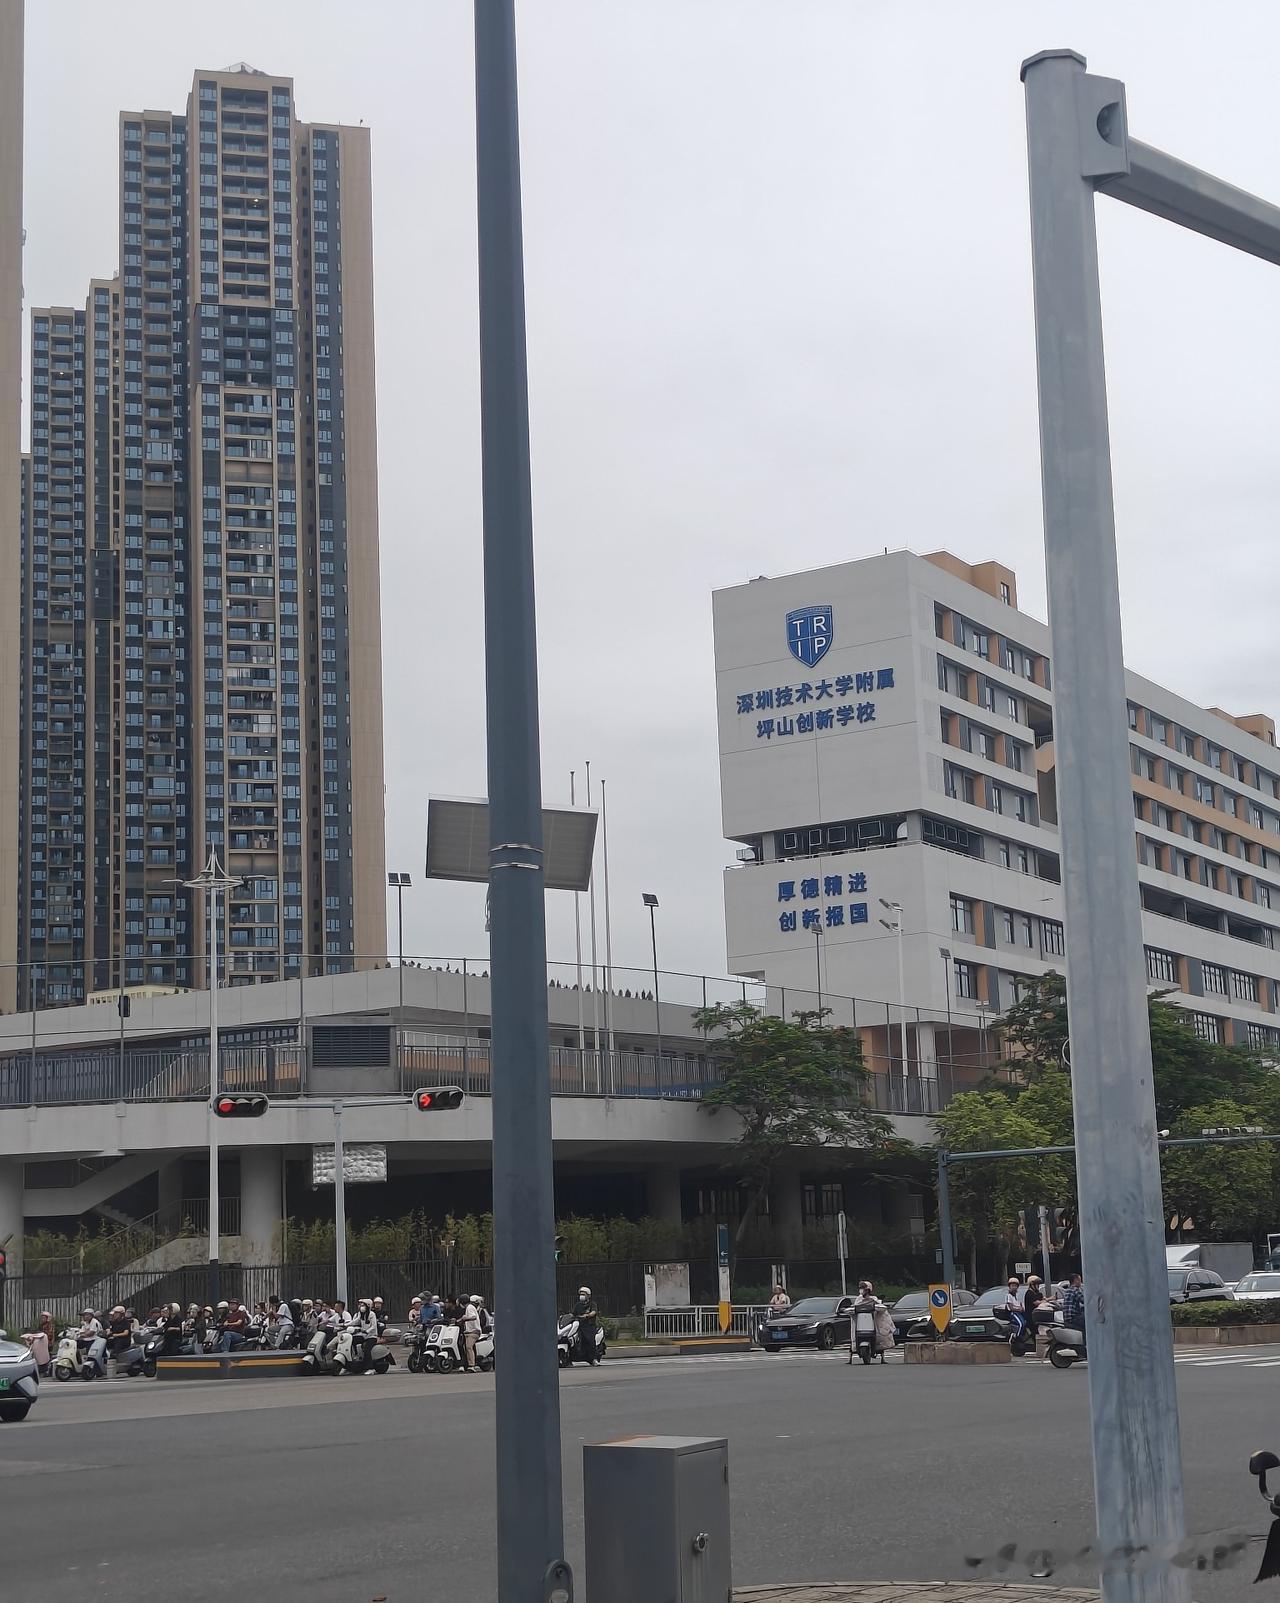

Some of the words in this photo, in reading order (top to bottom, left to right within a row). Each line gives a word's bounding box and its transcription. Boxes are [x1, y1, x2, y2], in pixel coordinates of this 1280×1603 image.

[736, 668, 895, 714] 深圳技术大学附属
[756, 701, 876, 739] 坪山创新学校
[777, 872, 867, 902] 厚德精进
[779, 902, 868, 932] 创新报国
